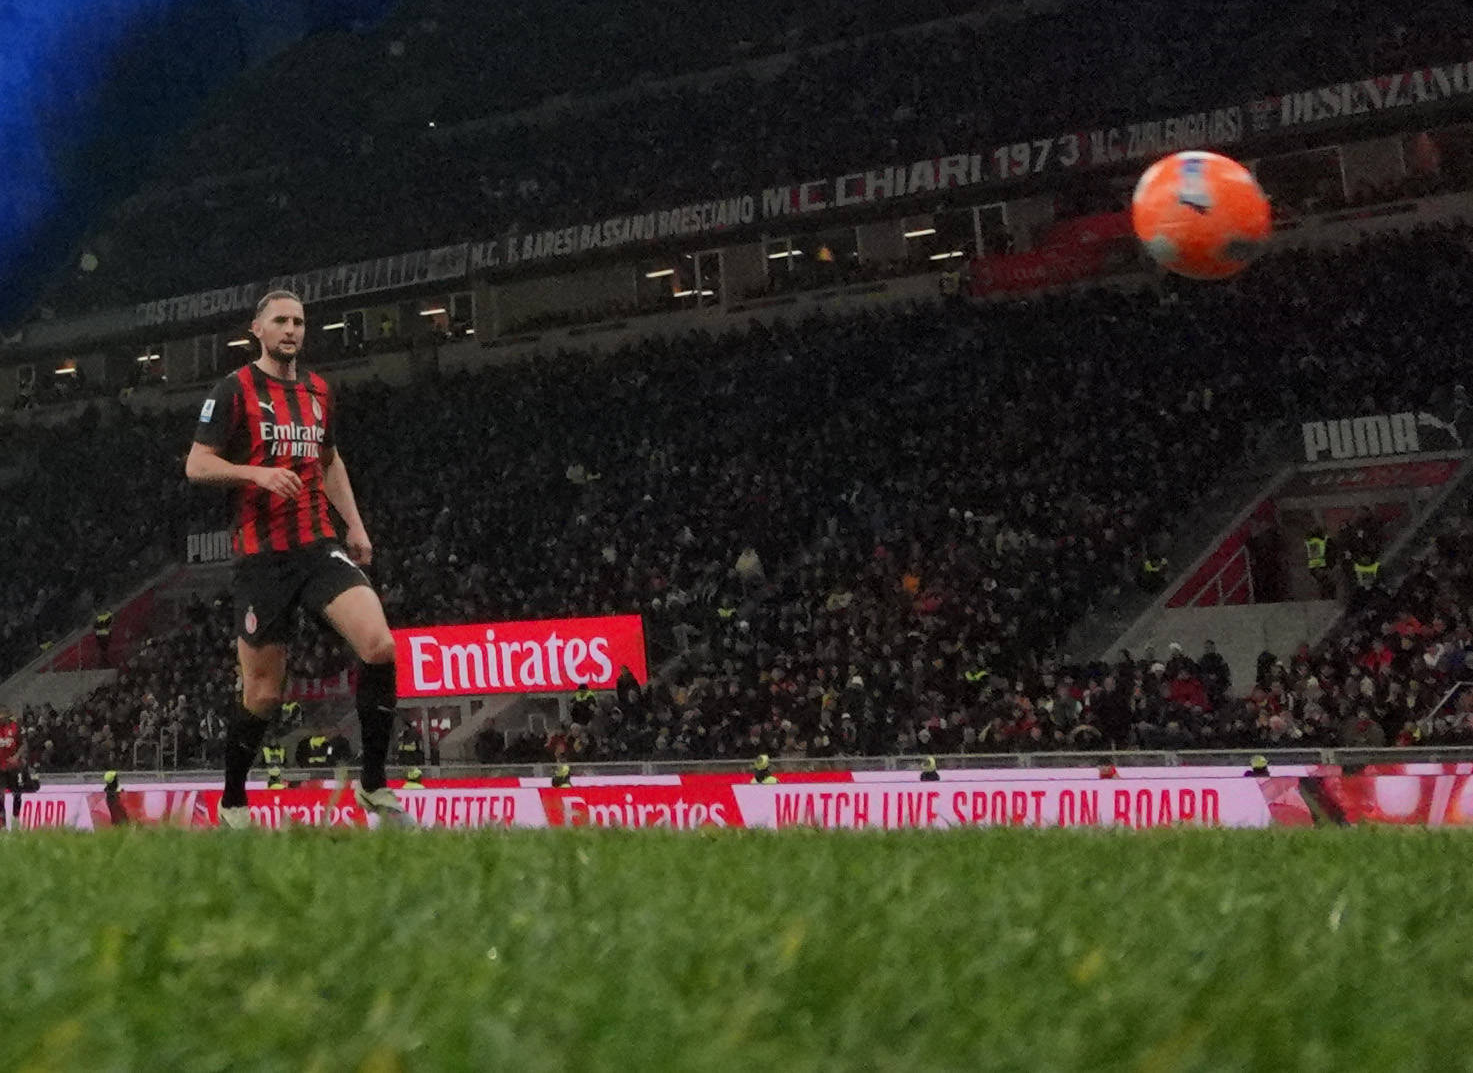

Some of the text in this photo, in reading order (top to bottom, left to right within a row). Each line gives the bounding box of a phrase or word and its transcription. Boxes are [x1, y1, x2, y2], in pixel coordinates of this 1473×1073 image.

[993, 132, 1082, 181] 1973
[259, 421, 325, 443] Emirate
[1302, 411, 1419, 462] PUMA
[409, 629, 614, 691] Emirates
[248, 797, 355, 828] mirates
[435, 796, 516, 826] BETTER
[562, 793, 727, 827] Emirates
[774, 788, 1220, 827] WATCH LIVE SPORT ON BOARD
